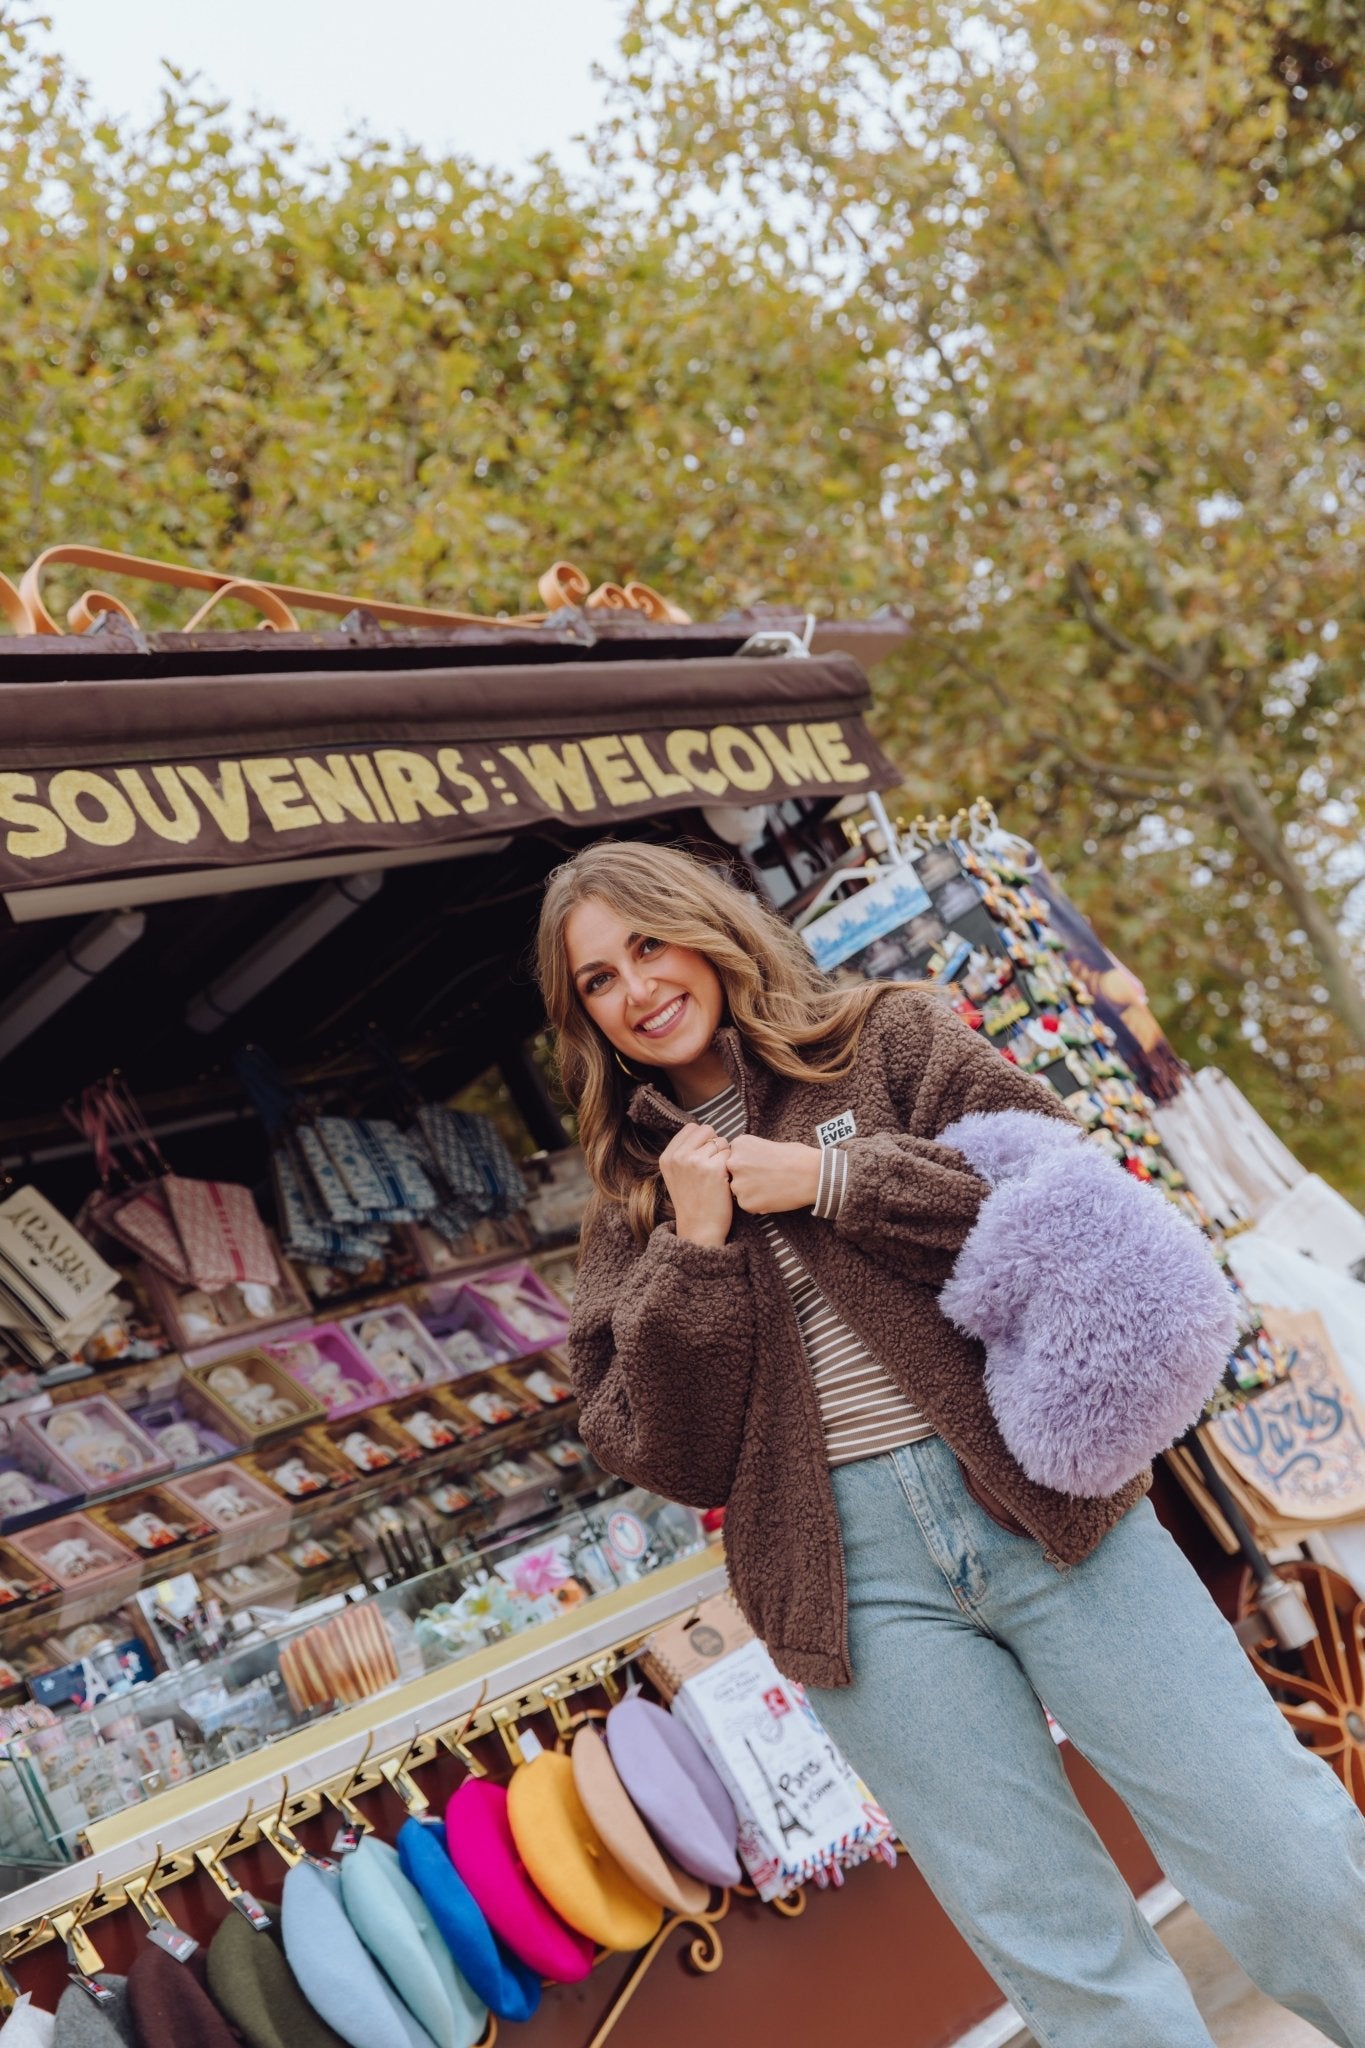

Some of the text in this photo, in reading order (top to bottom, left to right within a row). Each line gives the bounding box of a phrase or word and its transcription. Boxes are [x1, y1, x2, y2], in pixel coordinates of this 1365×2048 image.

[0, 722, 870, 859] SOUVENIRS WELCOME
[820, 1118, 845, 1135] FOR
[822, 1125, 853, 1146] EVER
[26, 1215, 92, 1287] PARIS
[779, 1761, 821, 1798] Paris
